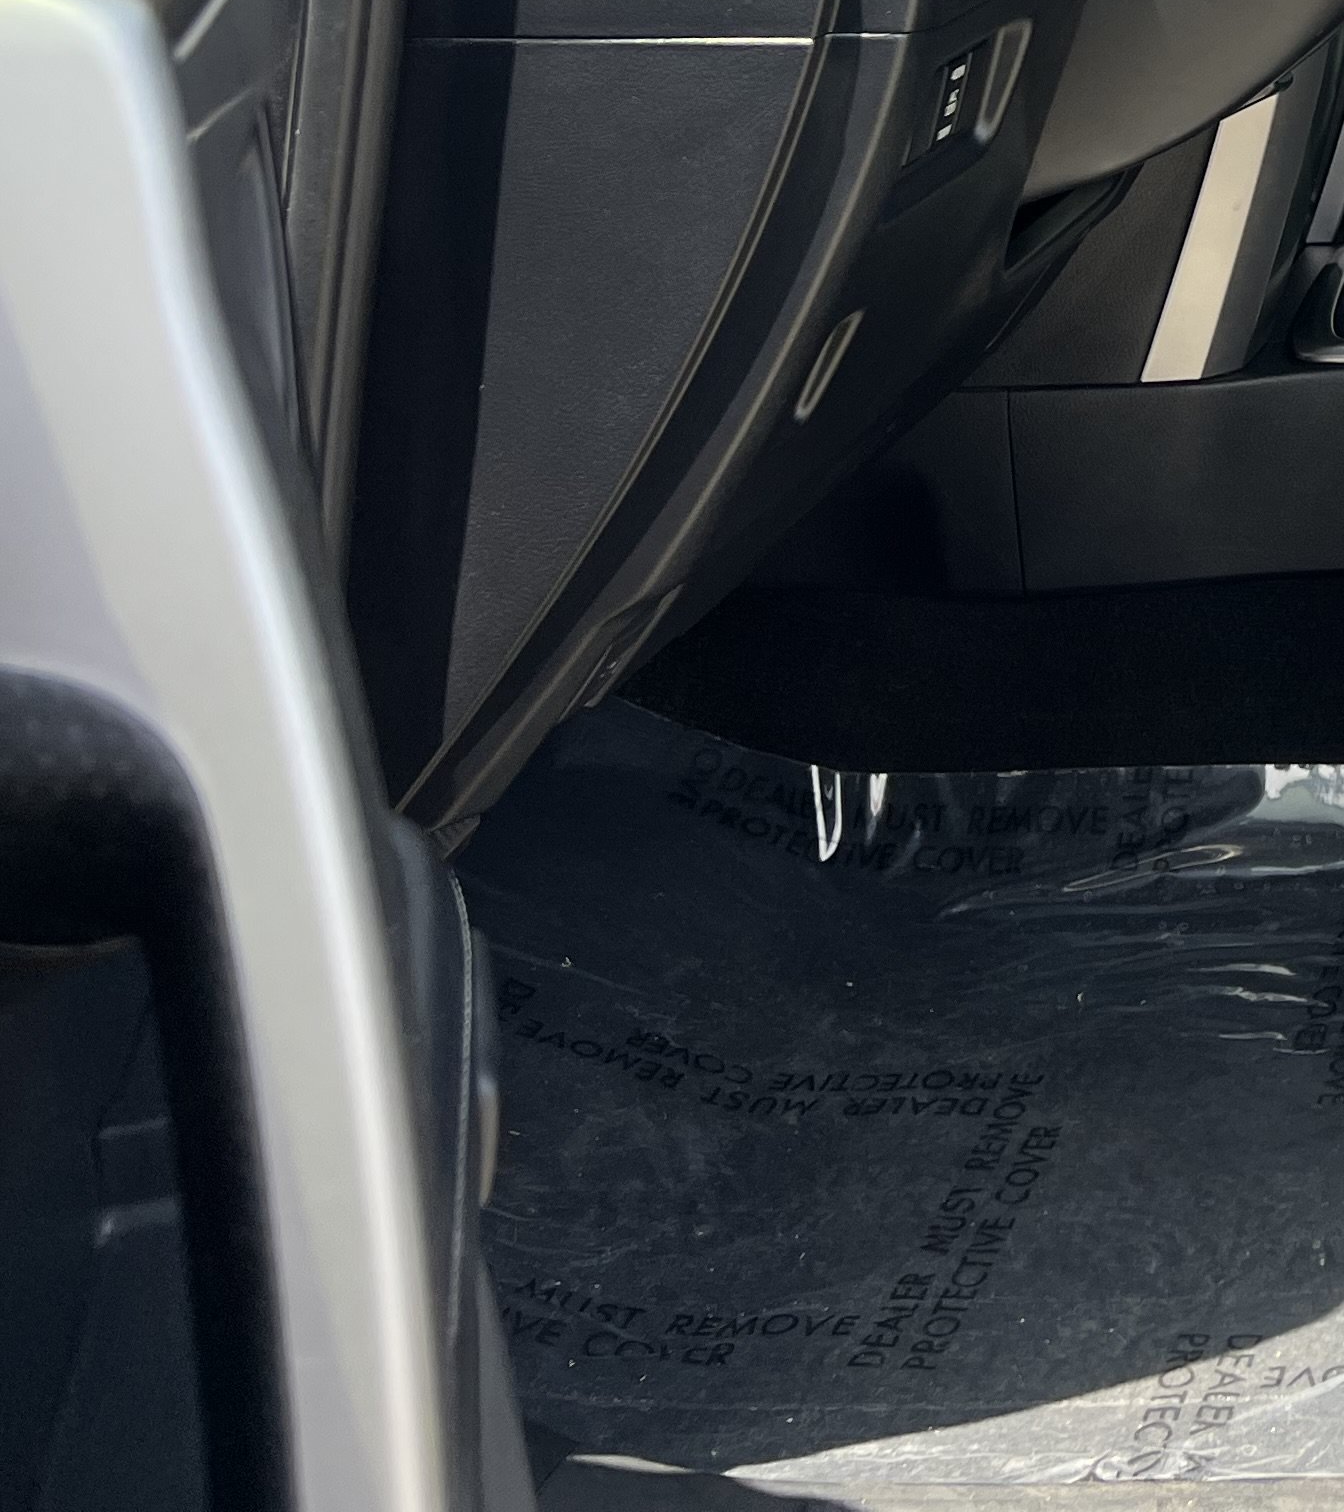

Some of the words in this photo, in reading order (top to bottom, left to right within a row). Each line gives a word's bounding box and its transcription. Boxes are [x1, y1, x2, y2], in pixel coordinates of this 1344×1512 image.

[515, 1018, 687, 1091] REMOVE
[626, 1027, 755, 1086] COVER
[700, 1085, 819, 1117] MUST
[767, 1069, 1003, 1093] PROTECTIVE
[842, 1096, 990, 1117] DEALER
[845, 1273, 937, 1370] DEALER
[918, 1186, 986, 1255] MUST
[962, 1072, 1046, 1173] REMOVE
[899, 1216, 1017, 1371] PROTECTIVE
[994, 1124, 1064, 1206] COVER
[663, 1312, 862, 1339] REMOVE
